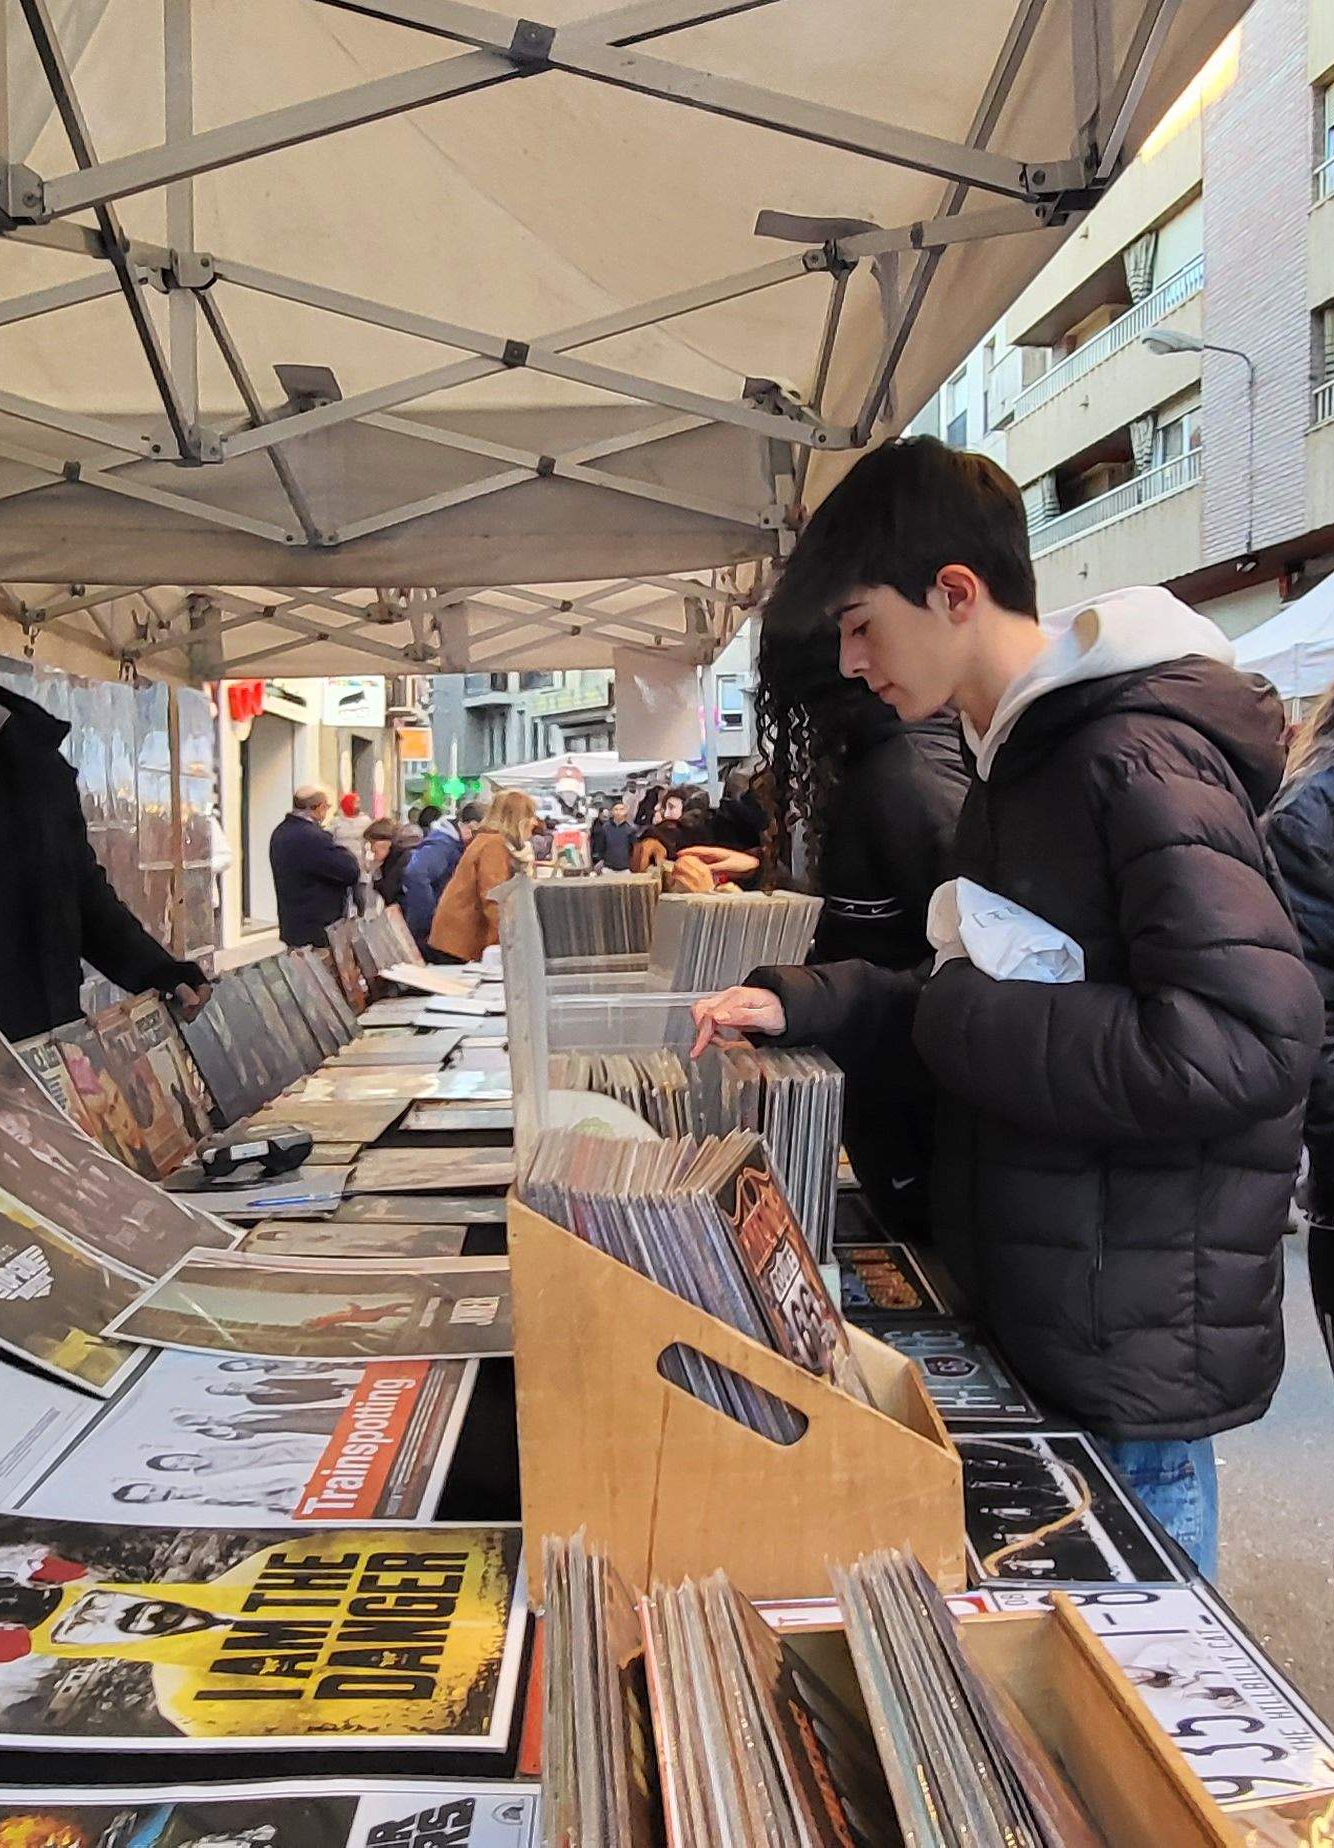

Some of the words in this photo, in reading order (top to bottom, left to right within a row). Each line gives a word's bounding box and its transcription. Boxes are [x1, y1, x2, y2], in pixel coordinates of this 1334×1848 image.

[301, 1377, 416, 1515] Trainspotting
[240, 1551, 361, 1613] THE
[209, 1619, 333, 1680] AM
[313, 1551, 470, 1701] DANGER
[1195, 1628, 1234, 1650] CAT
[193, 1688, 306, 1702] I
[1216, 1655, 1295, 1720] HILLBILLY
[1278, 1726, 1316, 1752] THE
